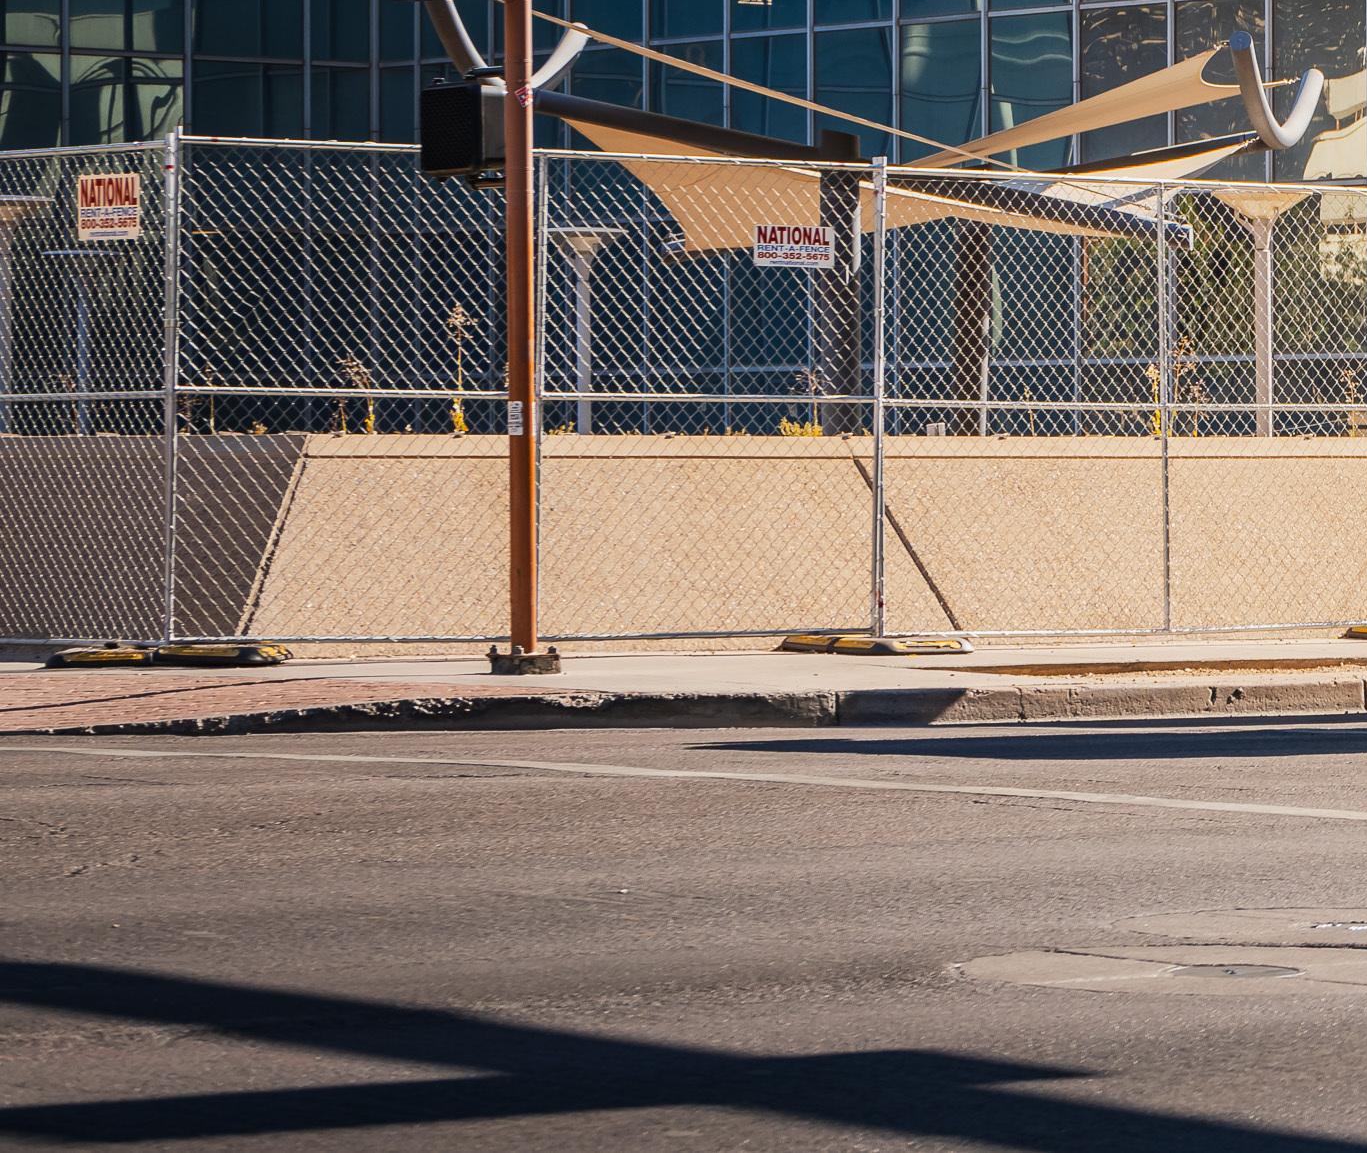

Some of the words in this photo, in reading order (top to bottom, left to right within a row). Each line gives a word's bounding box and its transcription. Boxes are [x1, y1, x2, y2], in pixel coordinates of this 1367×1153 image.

[80, 177, 138, 207] NATIONAL
[80, 207, 138, 217] RENT-A-FENCE
[757, 226, 829, 245] NATIONAL
[757, 244, 829, 253] RENT-A-FENCE
[757, 252, 830, 260] 800-352-5675
